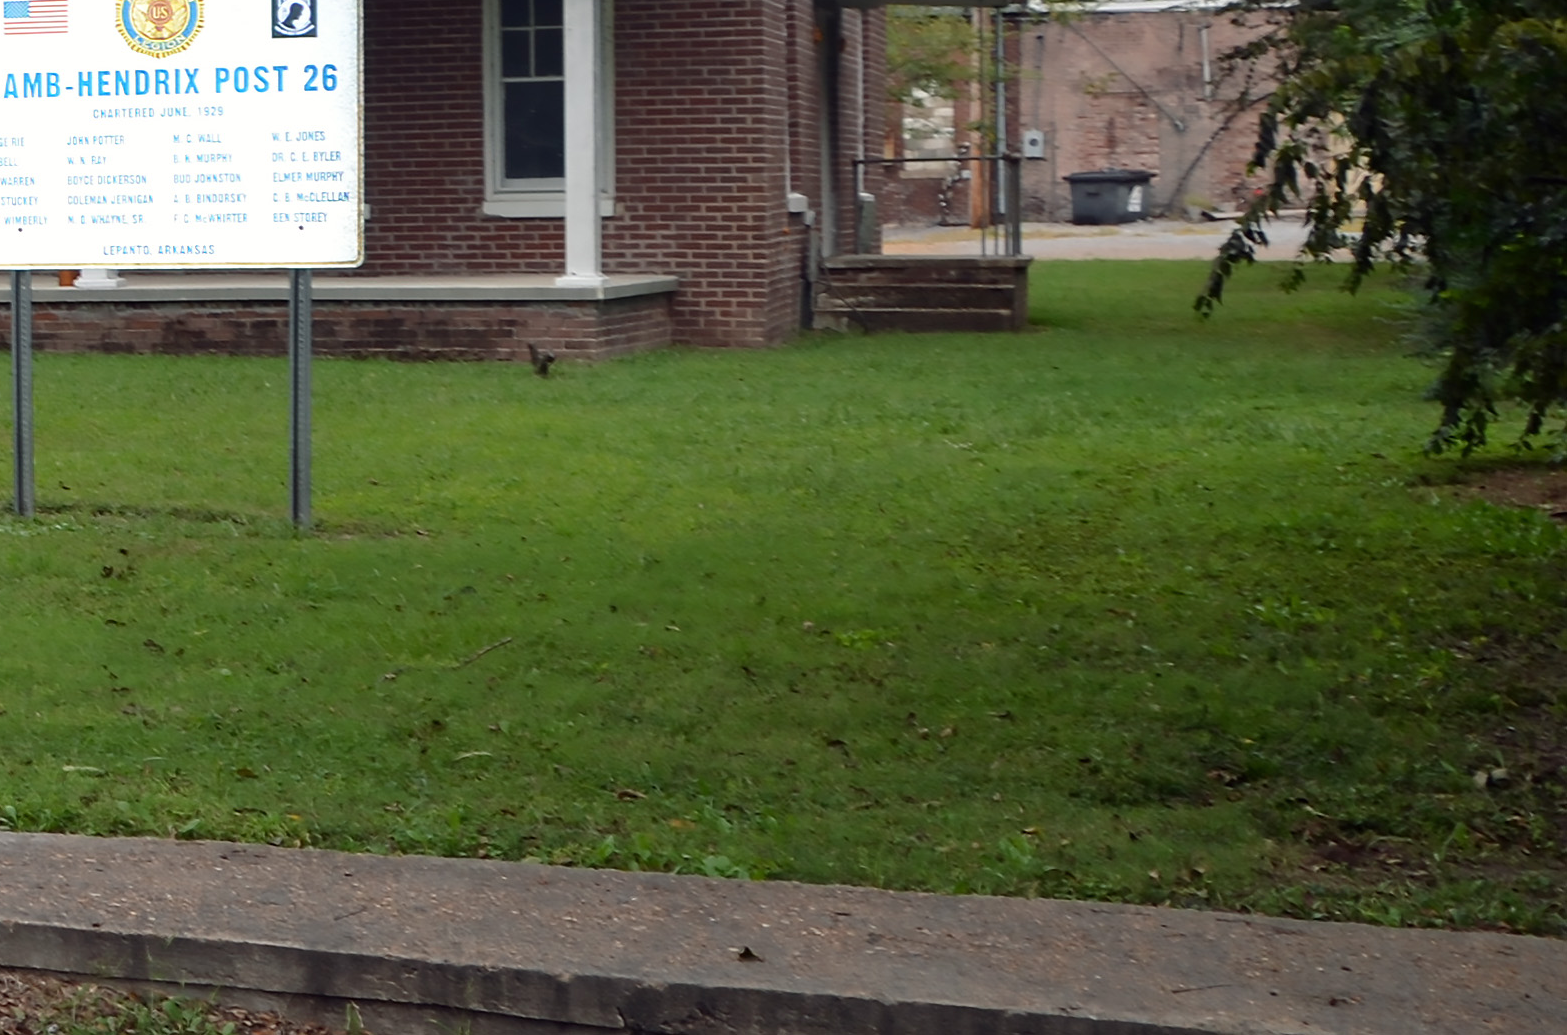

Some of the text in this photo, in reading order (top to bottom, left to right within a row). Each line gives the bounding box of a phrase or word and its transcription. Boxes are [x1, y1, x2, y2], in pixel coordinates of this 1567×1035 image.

[152, 6, 168, 19] US
[134, 35, 186, 51] LEGION
[215, 65, 289, 94] POST
[303, 64, 338, 92] 26
[93, 108, 155, 119] CHARTERED
[198, 106, 224, 116] 1929
[67, 135, 125, 145] JOHN POTTER
[198, 133, 222, 143] WALL
[296, 131, 326, 141] JONES
[91, 155, 106, 165] RAY
[196, 153, 232, 163] MURPHY
[313, 151, 342, 161] BYLER
[0, 177, 35, 186] WARREN
[67, 175, 147, 185] BOYCE DICKERSON
[194, 173, 241, 183] JOHNSTON
[273, 171, 344, 182] ELMER MURPHY
[1, 196, 39, 206] STUCKEY
[68, 195, 153, 205] COLEMAN JERNIGAN
[296, 191, 350, 202] McCLELLAN
[5, 216, 47, 225] WIMBERLY
[195, 213, 248, 223] McWHIRTER
[273, 212, 328, 222] BEN STOREY
[103, 245, 215, 255] LEPANTO, ARKANSAS
